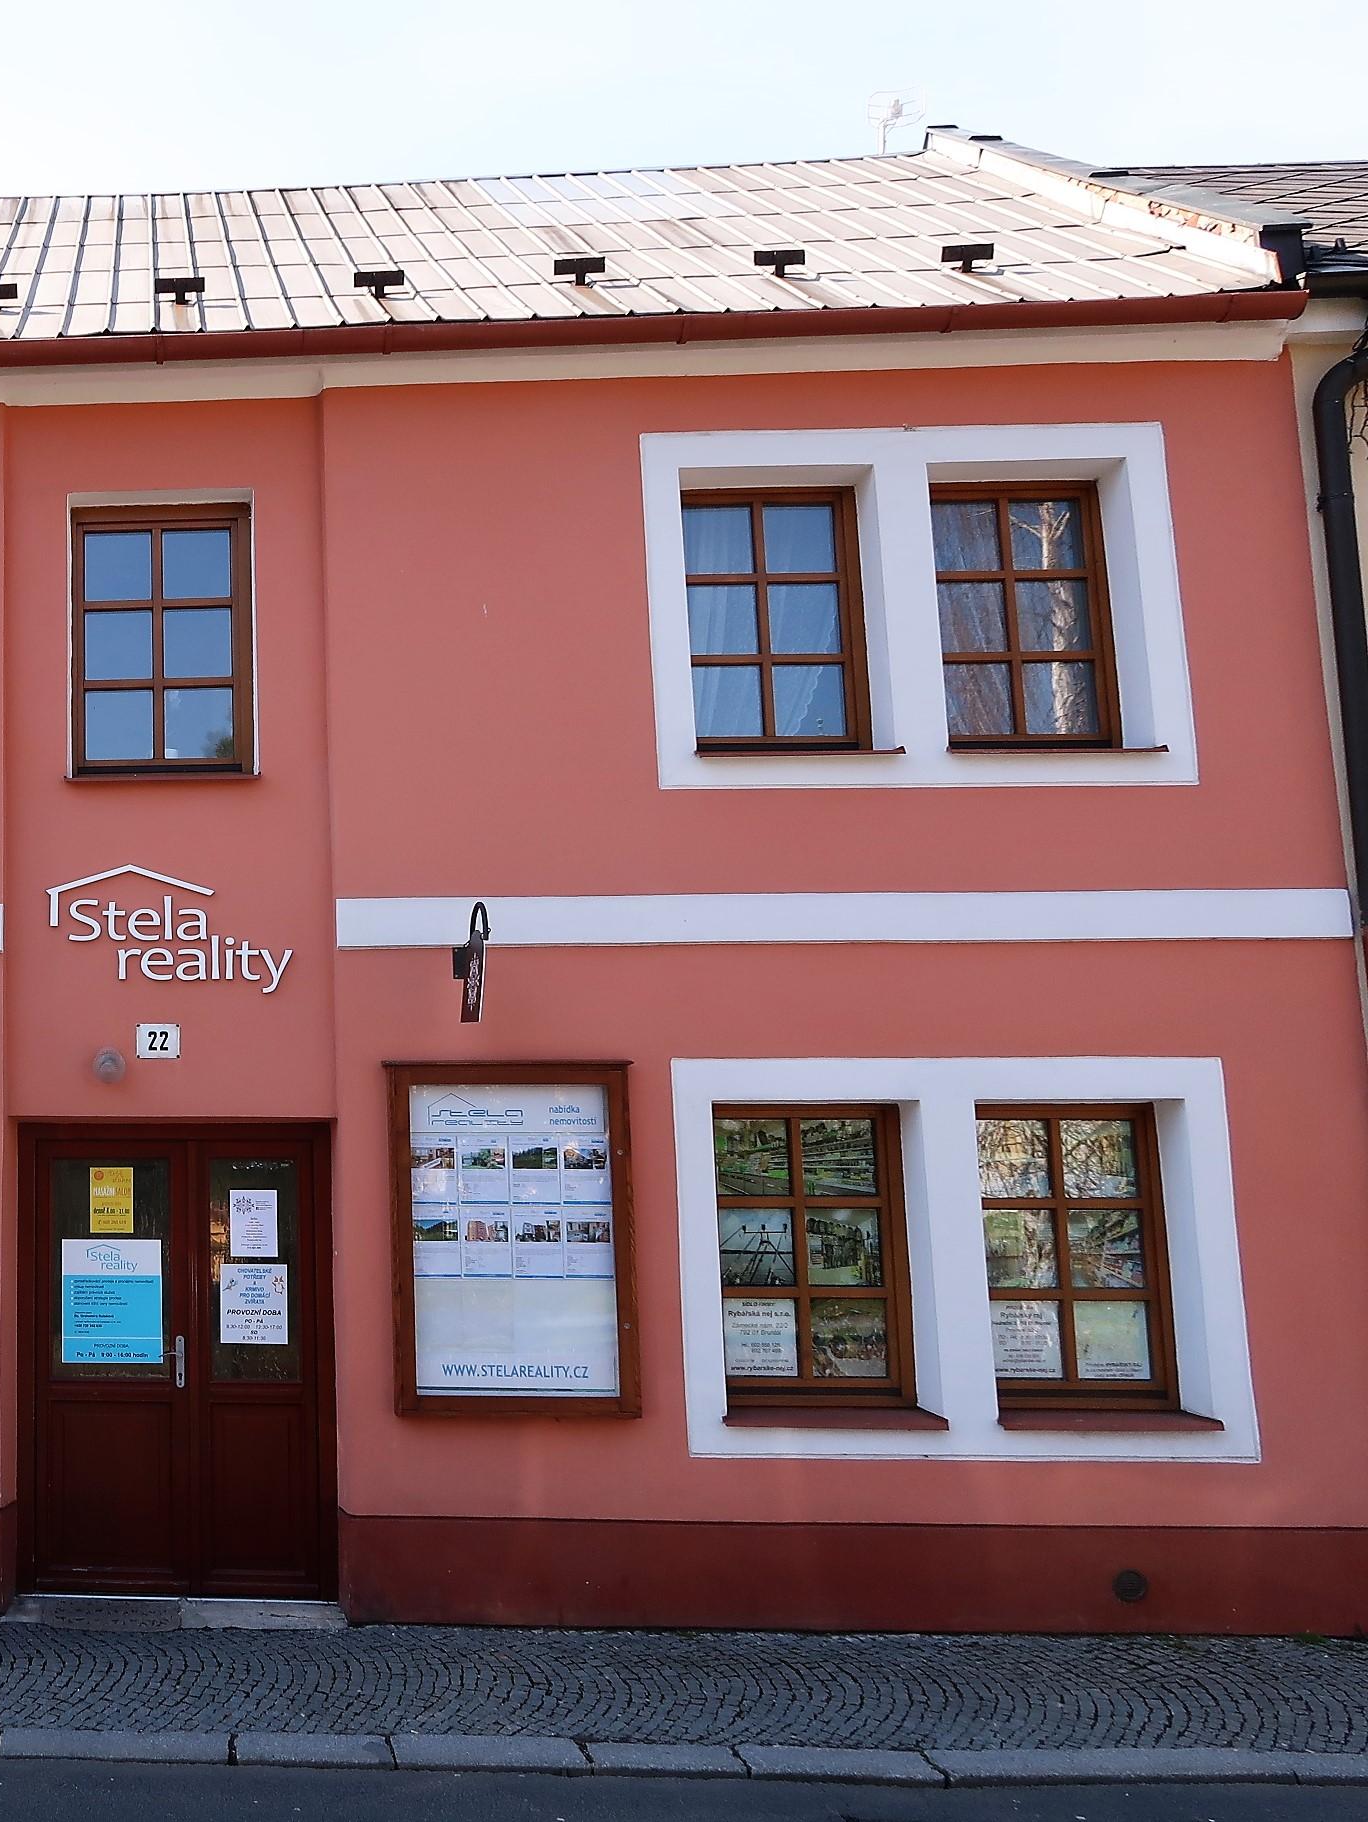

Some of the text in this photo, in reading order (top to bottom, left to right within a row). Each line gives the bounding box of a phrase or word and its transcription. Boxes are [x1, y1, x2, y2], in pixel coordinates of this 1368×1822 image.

[67, 895, 208, 942] Stela
[117, 935, 293, 994] reality
[147, 1030, 169, 1052] 22
[90, 1251, 121, 1262] Stela
[100, 1260, 138, 1273] reality
[226, 1308, 261, 1316] PROVOZNÍ
[441, 1363, 590, 1379] WWW.STELAREALITY.CZ
